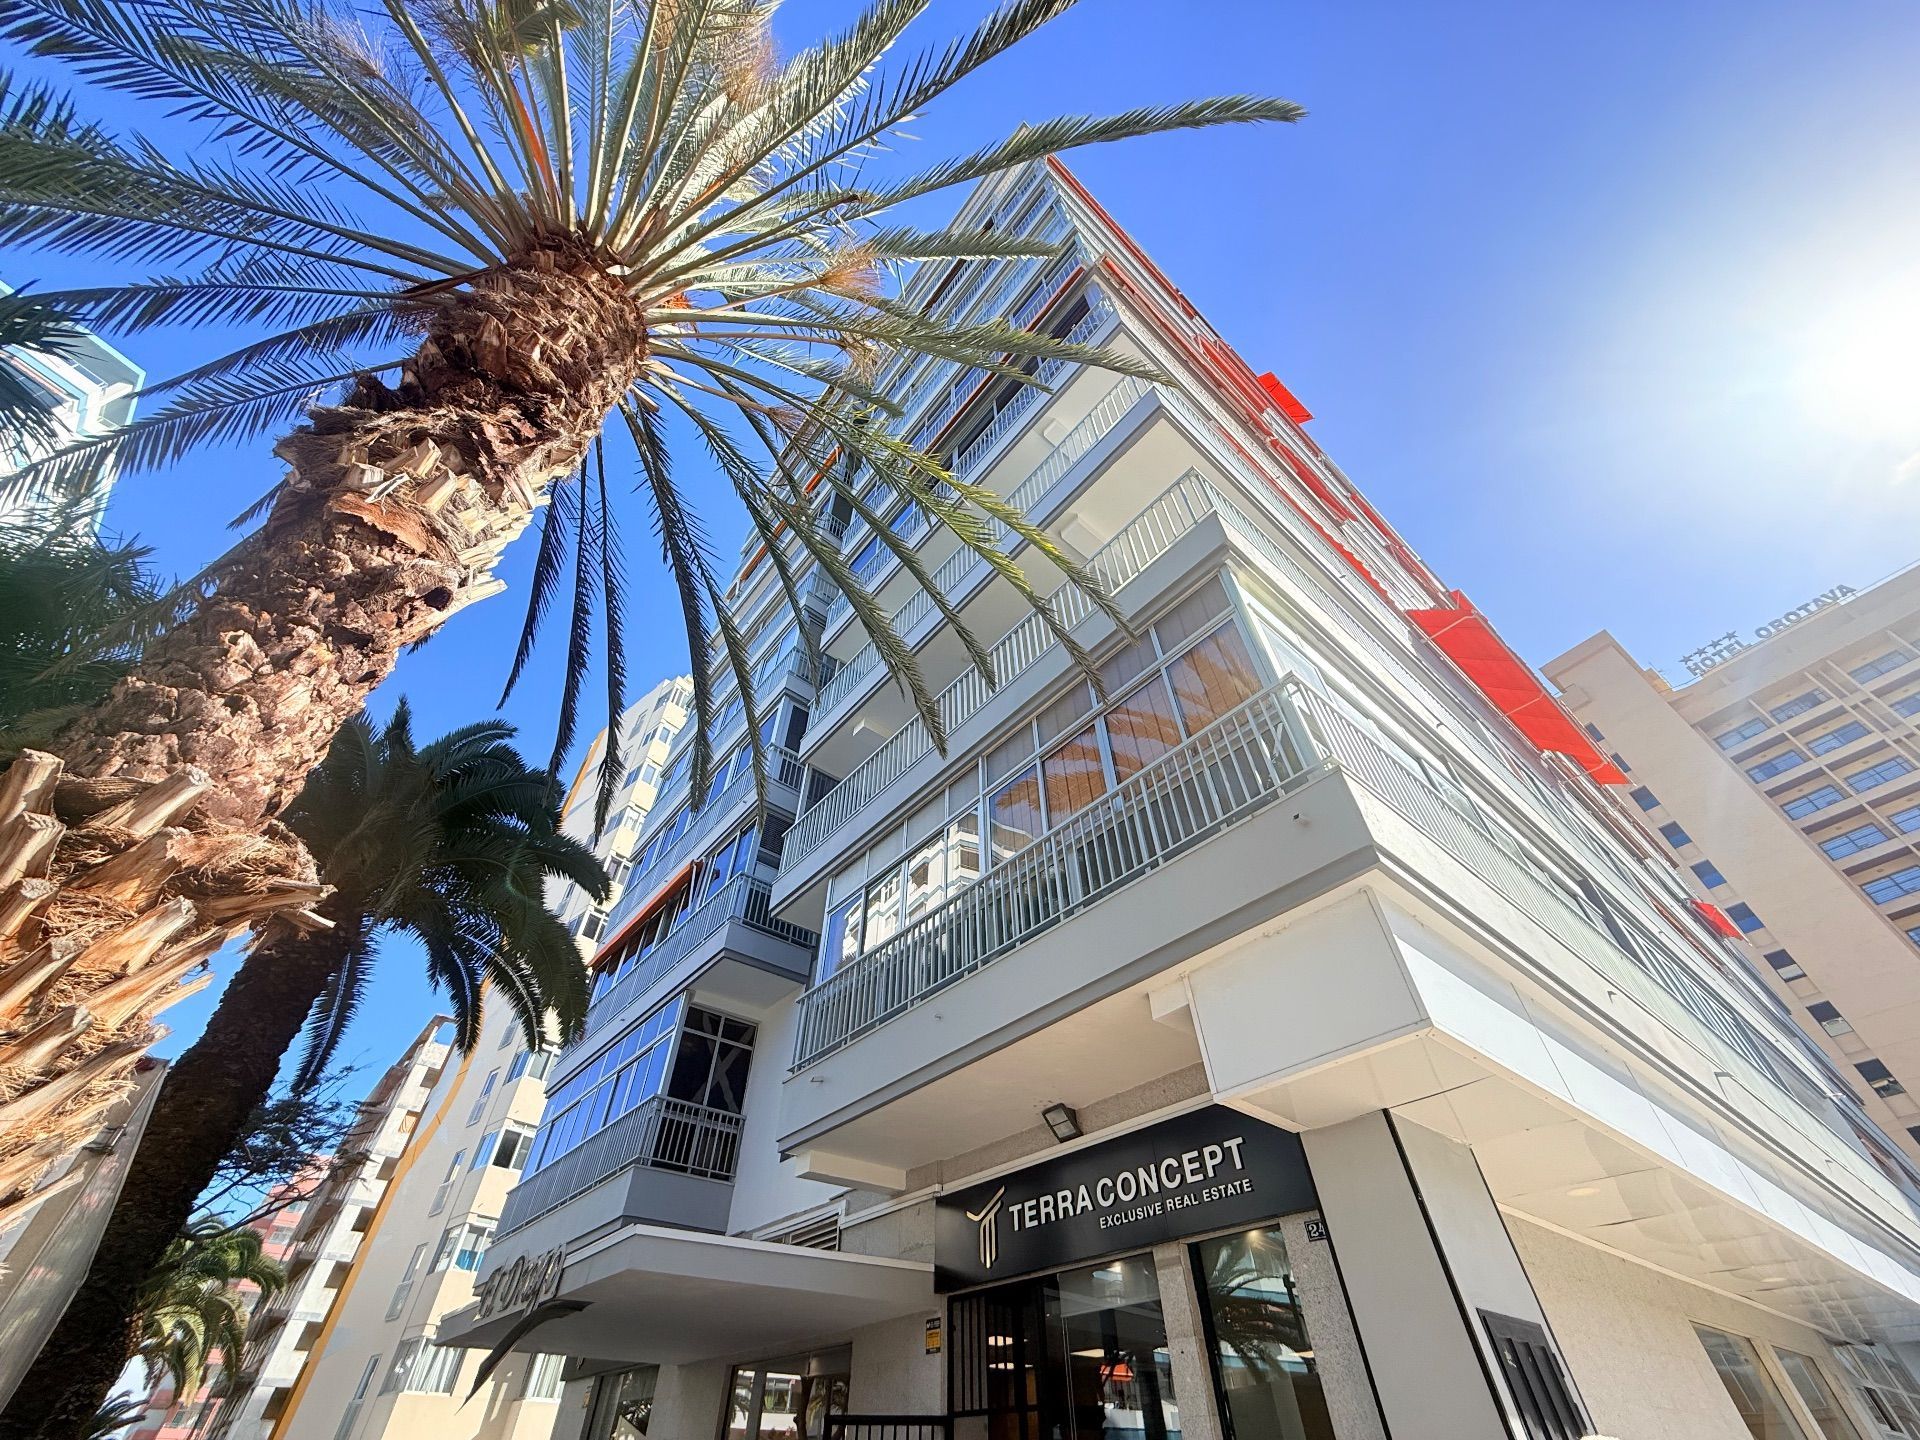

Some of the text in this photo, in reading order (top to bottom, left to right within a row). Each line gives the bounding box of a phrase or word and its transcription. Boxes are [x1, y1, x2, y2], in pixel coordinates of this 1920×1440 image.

[1686, 584, 1857, 676] HOTEL OROTAVA
[1099, 1178, 1252, 1229] EXCLUSIVE REAL ESTATE
